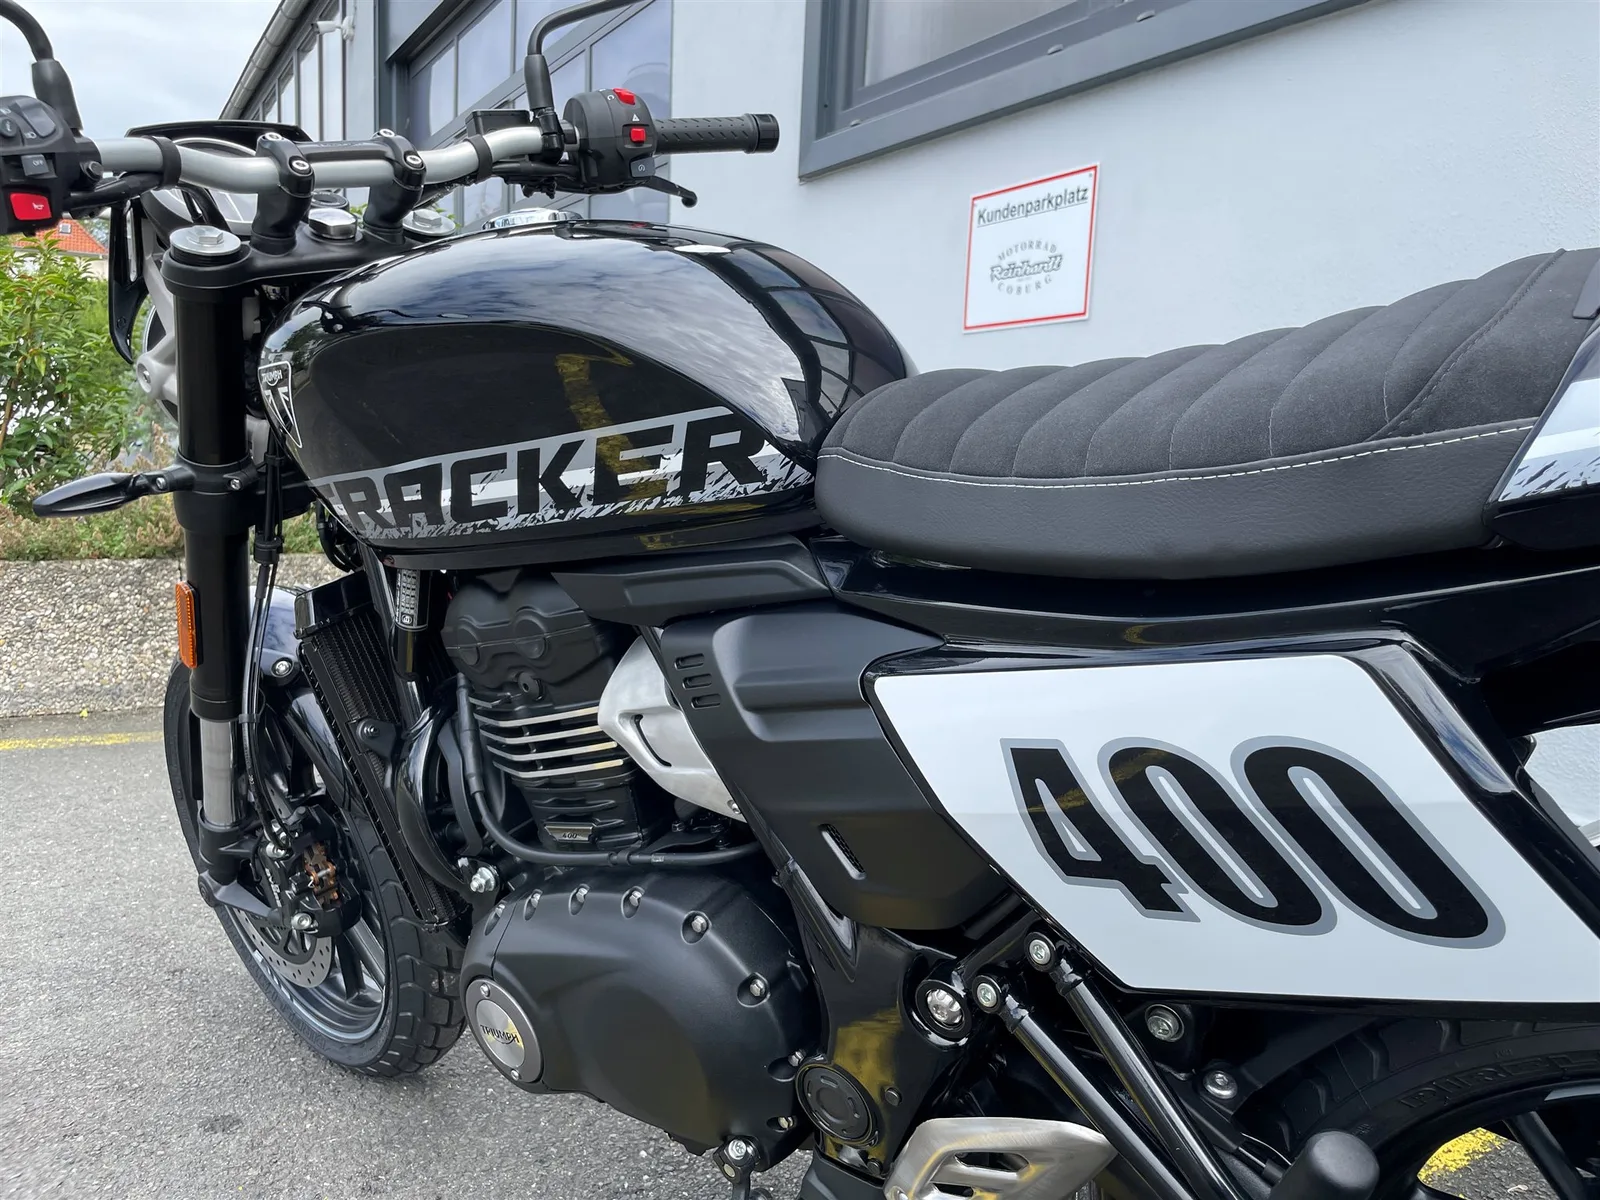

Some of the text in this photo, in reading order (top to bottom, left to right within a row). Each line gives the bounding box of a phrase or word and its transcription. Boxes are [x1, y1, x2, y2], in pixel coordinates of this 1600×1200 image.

[977, 187, 1089, 225] Kundenparkplatz
[998, 239, 1057, 260] MOTORRAD
[997, 274, 1053, 296] COBURG
[1000, 735, 1506, 950] 400
[480, 1024, 520, 1045] TRIUMPH
[1398, 1053, 1600, 1109] PIREL
